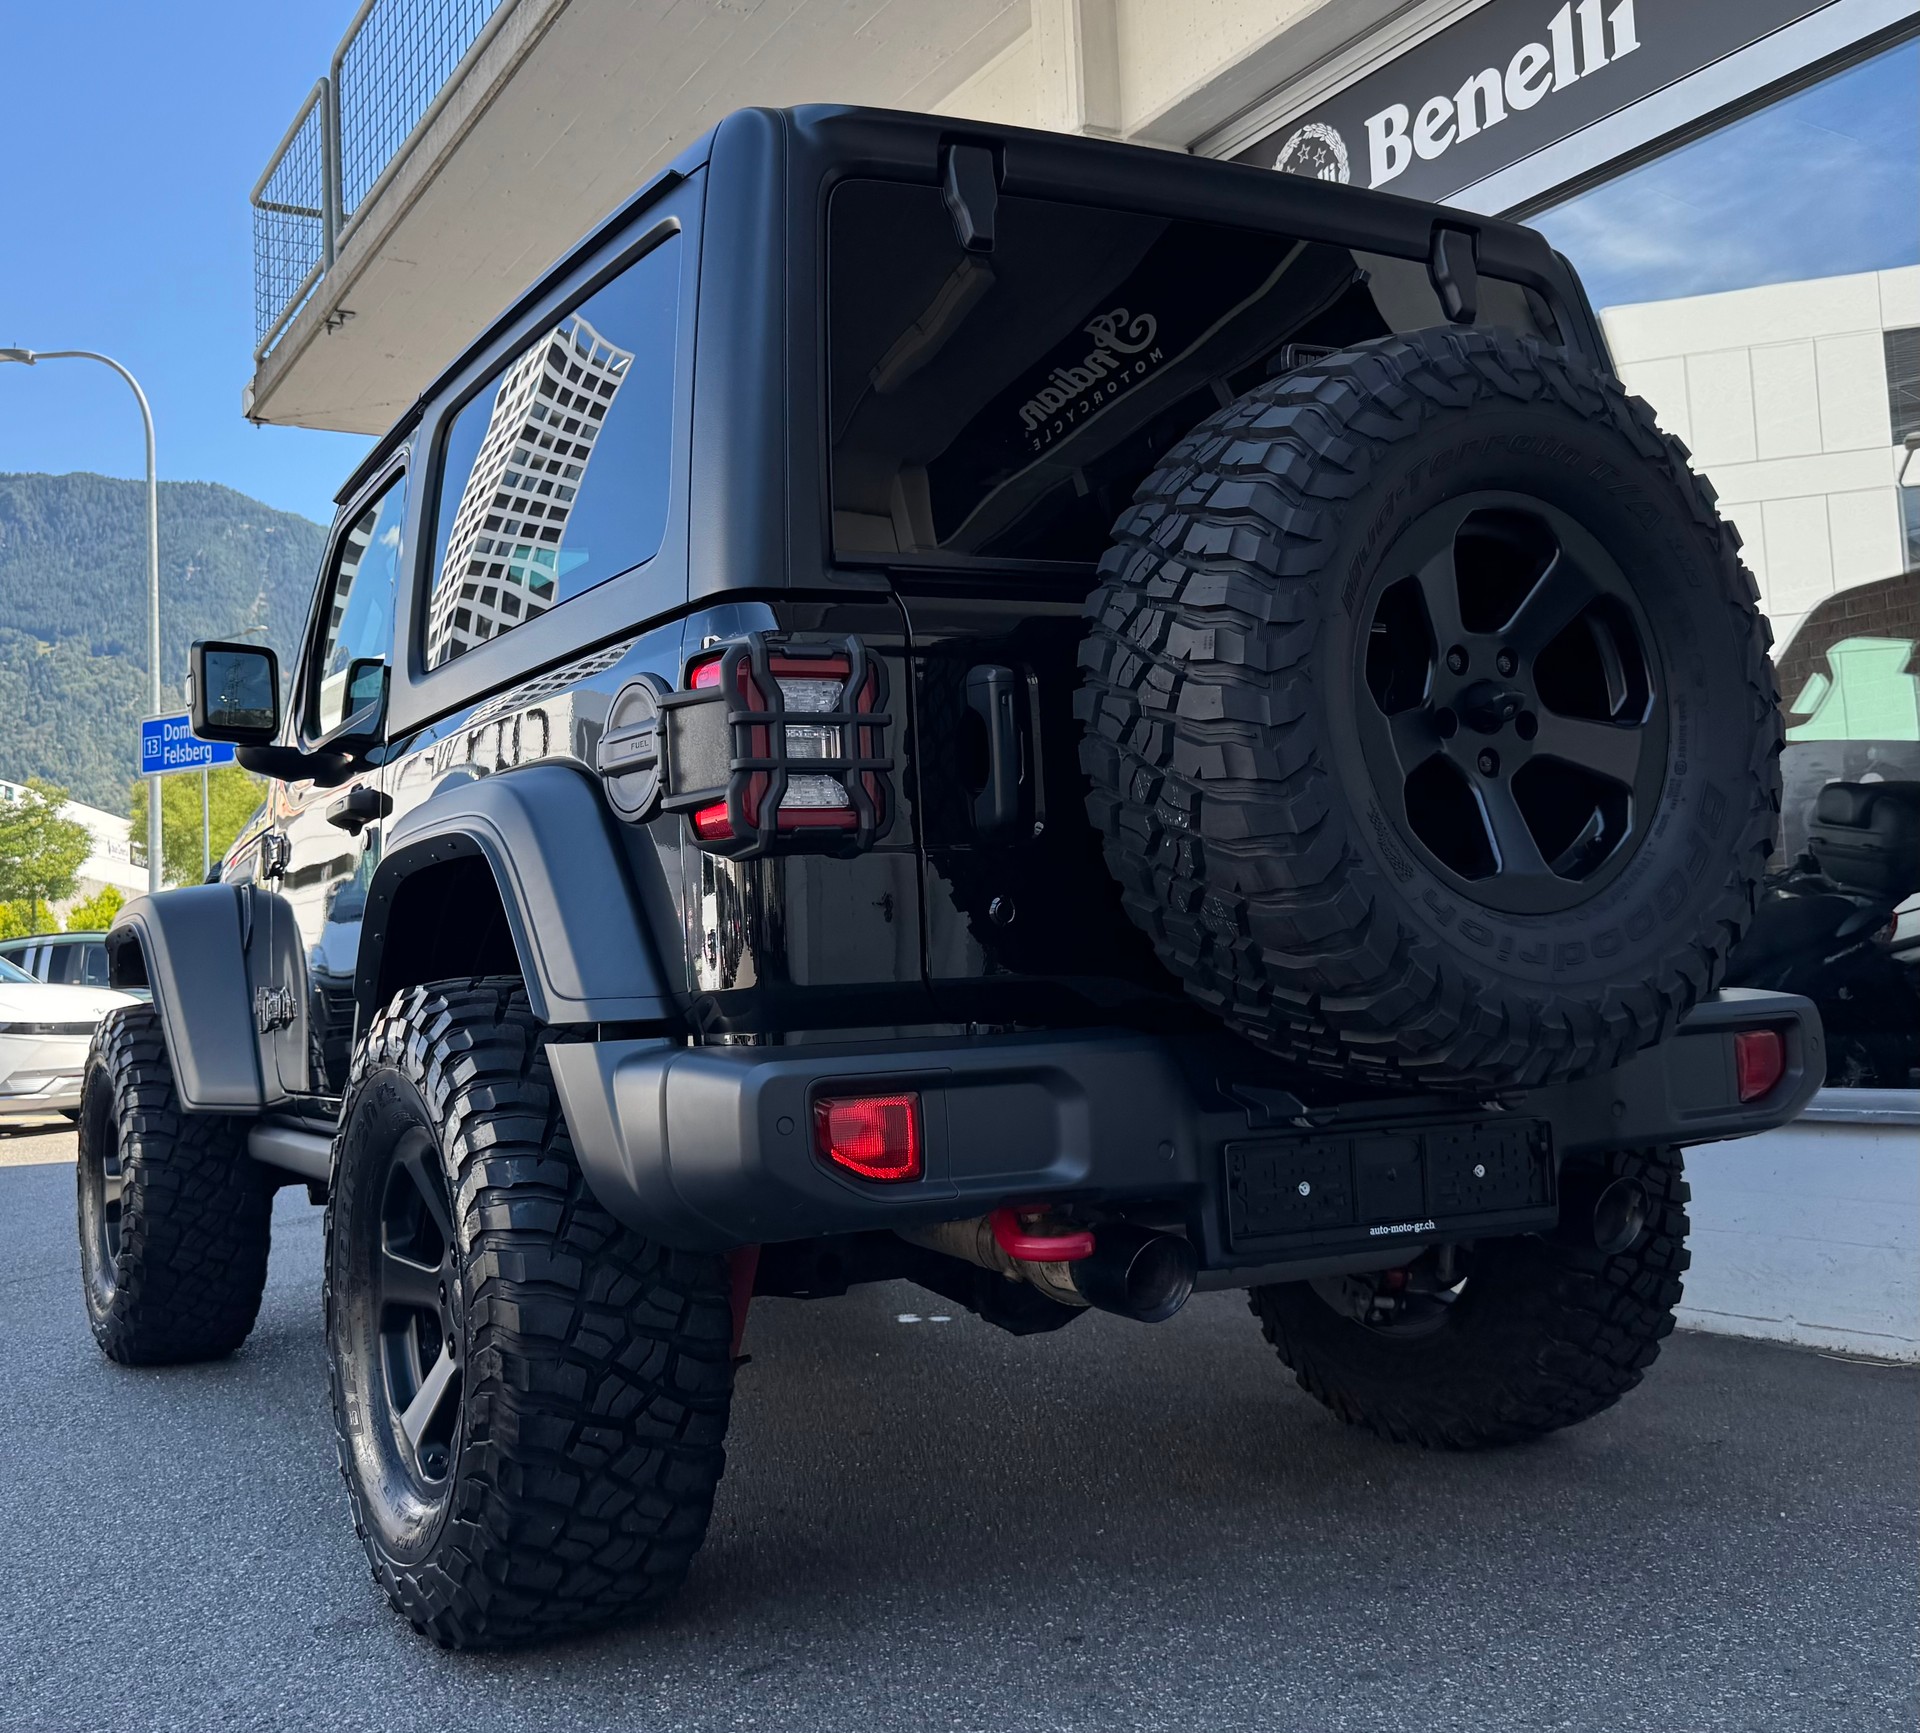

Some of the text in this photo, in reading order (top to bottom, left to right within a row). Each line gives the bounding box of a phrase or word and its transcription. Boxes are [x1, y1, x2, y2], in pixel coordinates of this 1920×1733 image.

[1364, 0, 1641, 190] Benelli
[146, 739, 158, 755] 13
[163, 742, 212, 764] Felsberg
[630, 739, 649, 751] FUEL
[1421, 775, 1729, 973] BFGoodrich
[1368, 1219, 1436, 1236] auto-moto-gr.ch
